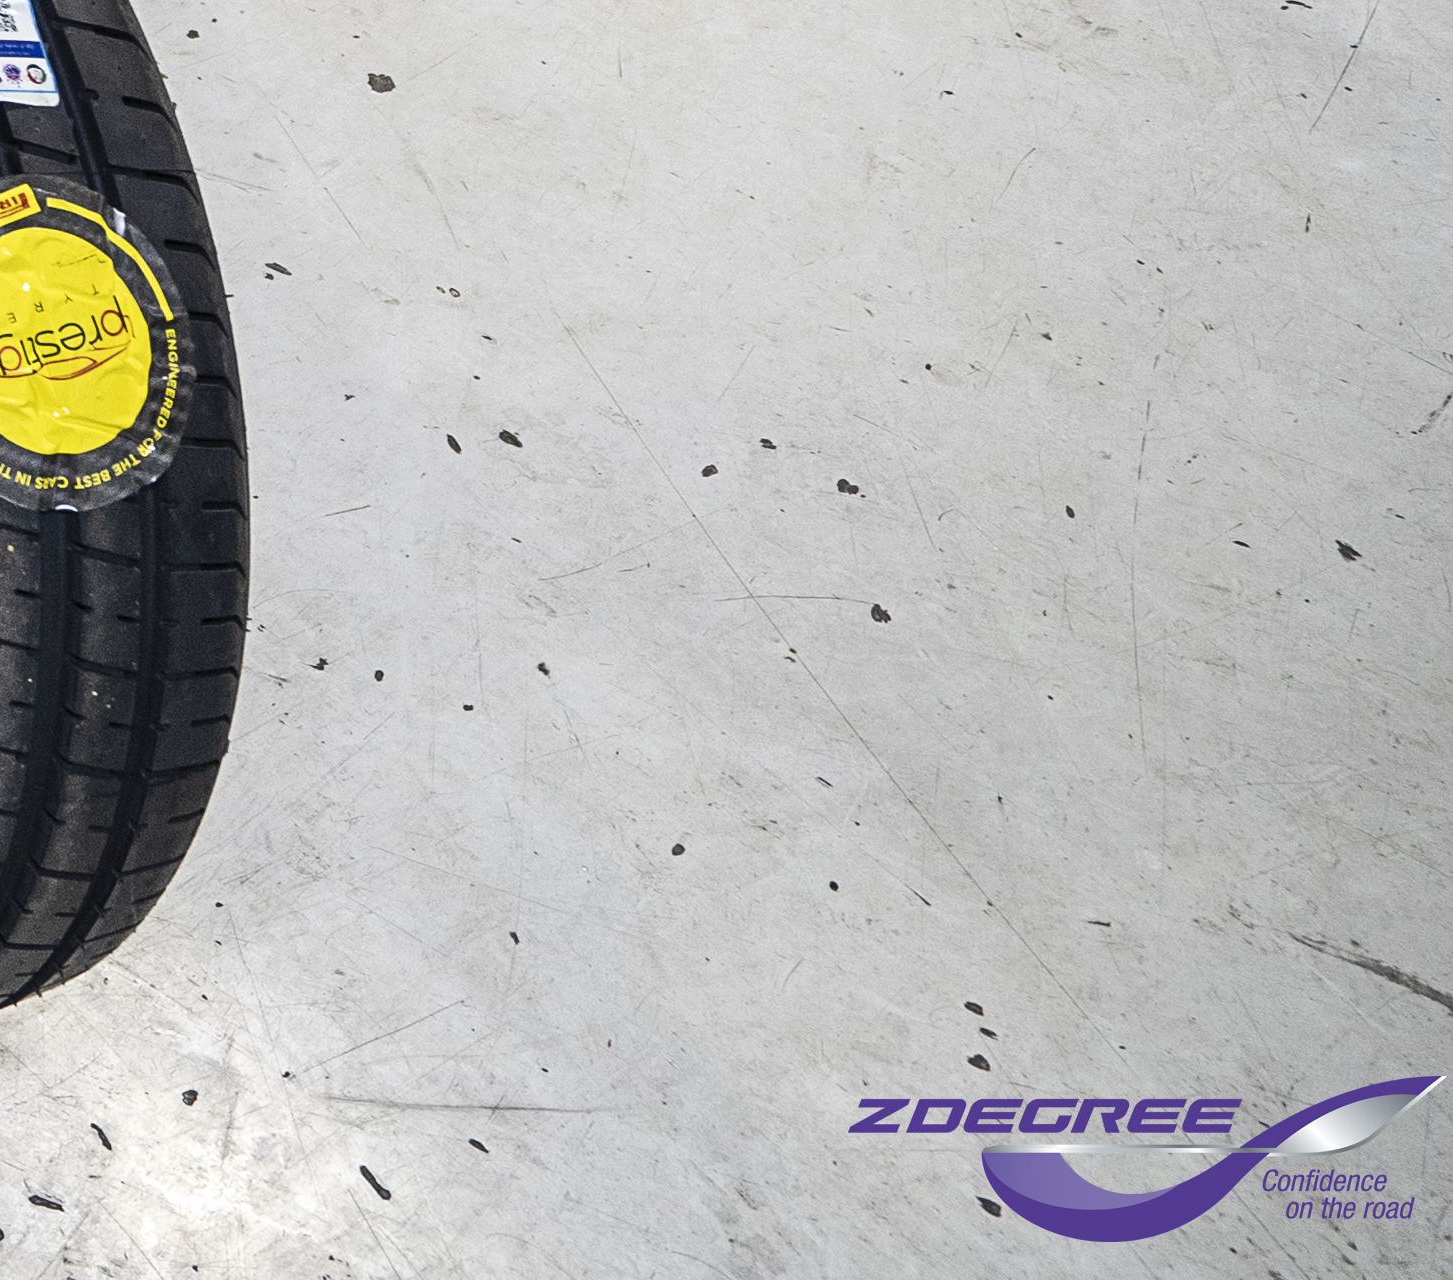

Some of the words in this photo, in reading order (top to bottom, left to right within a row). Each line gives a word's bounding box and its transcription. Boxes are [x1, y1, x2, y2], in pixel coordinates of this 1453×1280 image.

[157, 328, 179, 429] ENGINEERED
[136, 429, 163, 459] FOR
[114, 454, 141, 477] THE
[14, 470, 32, 487] IN
[34, 474, 69, 490] CARS
[74, 471, 112, 490] BEST
